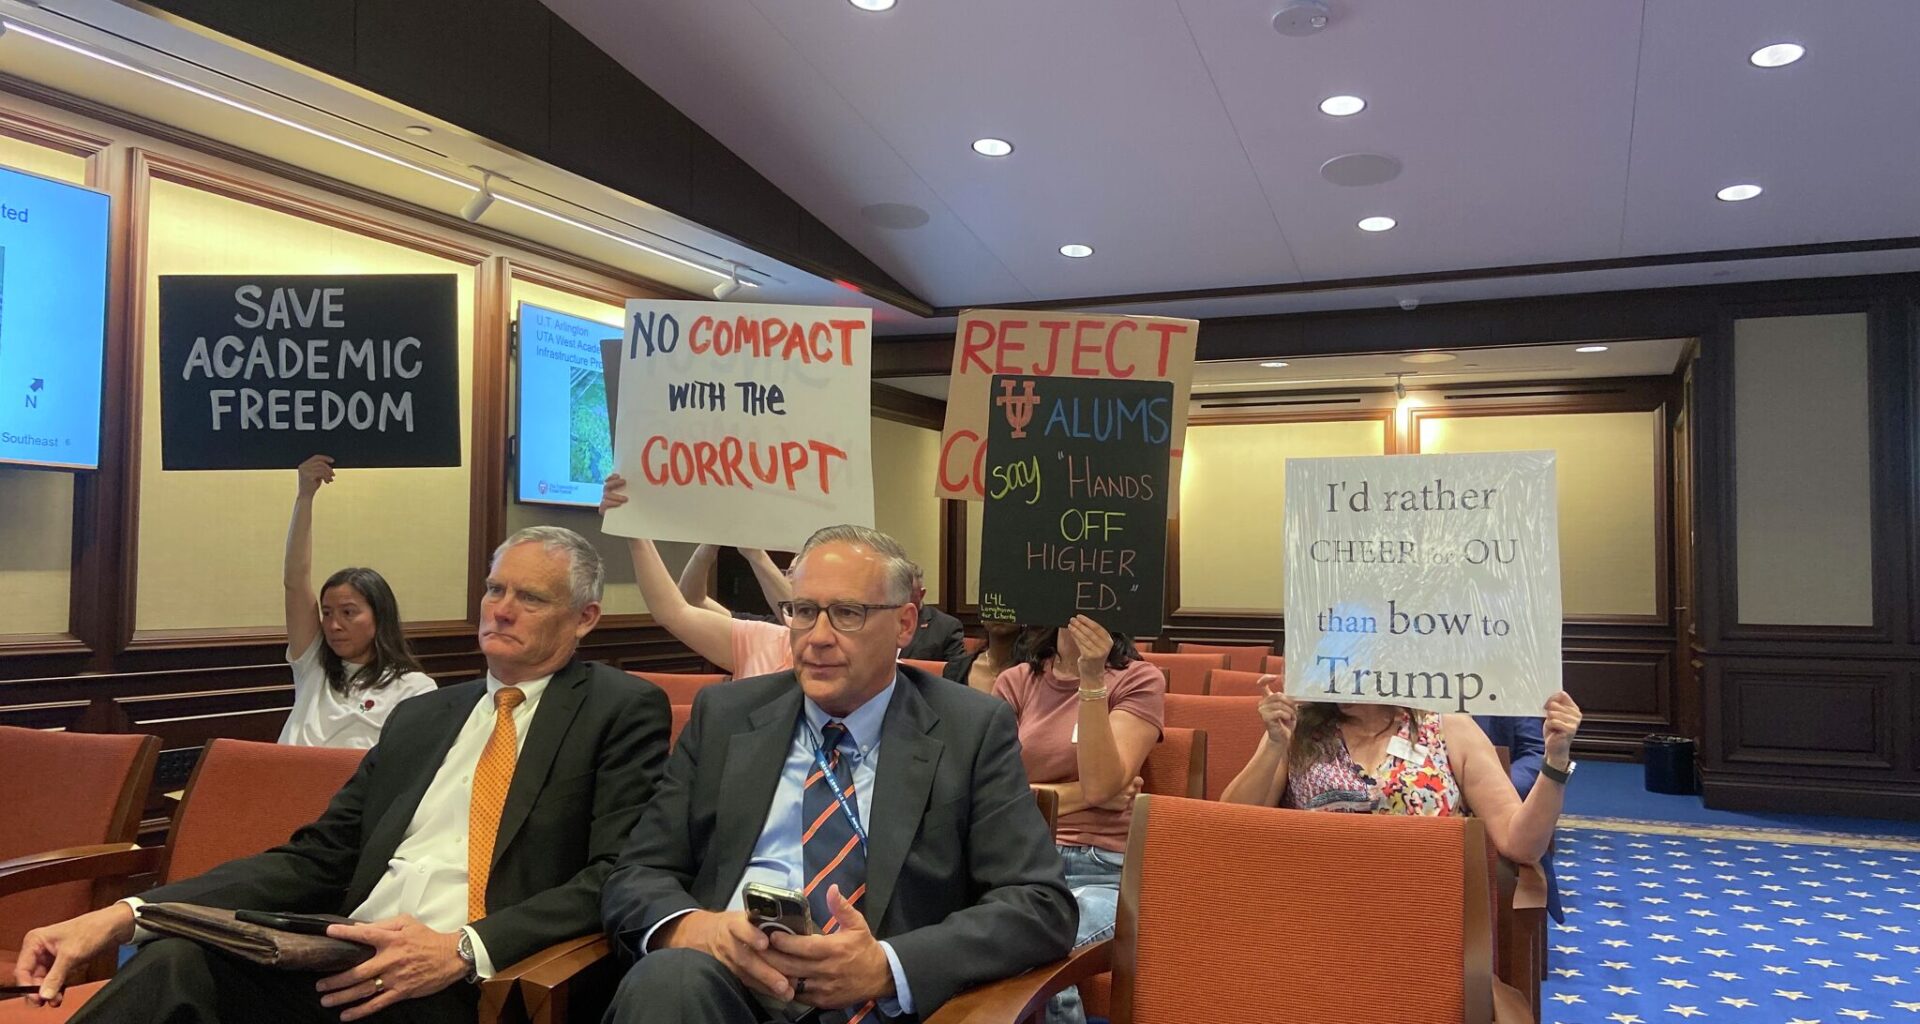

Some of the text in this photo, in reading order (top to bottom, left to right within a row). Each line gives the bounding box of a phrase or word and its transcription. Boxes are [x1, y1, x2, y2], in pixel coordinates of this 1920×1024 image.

[234, 285, 345, 330] SAVE
[537, 331, 554, 344] UTA
[556, 335, 576, 347] West
[554, 319, 589, 336] Arlington
[630, 311, 866, 366] NO COMPACT
[182, 335, 423, 381] ACADEMIC
[537, 345, 588, 366] Infrastructure
[959, 319, 1187, 379] REJECT
[25, 394, 37, 408] N
[210, 387, 414, 432] FREEDOM
[668, 380, 726, 412] WITH
[1044, 397, 1171, 445] ALUMS
[2, 432, 58, 447] Southeast
[641, 435, 848, 495] CORRUPT
[1326, 478, 1497, 513] I'd rather
[1060, 508, 1127, 542] OFF
[1026, 541, 1137, 578] HIGHER
[1310, 539, 1417, 564] CHEER
[1463, 538, 1518, 565] OU
[984, 592, 1006, 606] L4L
[1317, 599, 1510, 637] than bow to
[1316, 655, 1497, 713] Trump.
